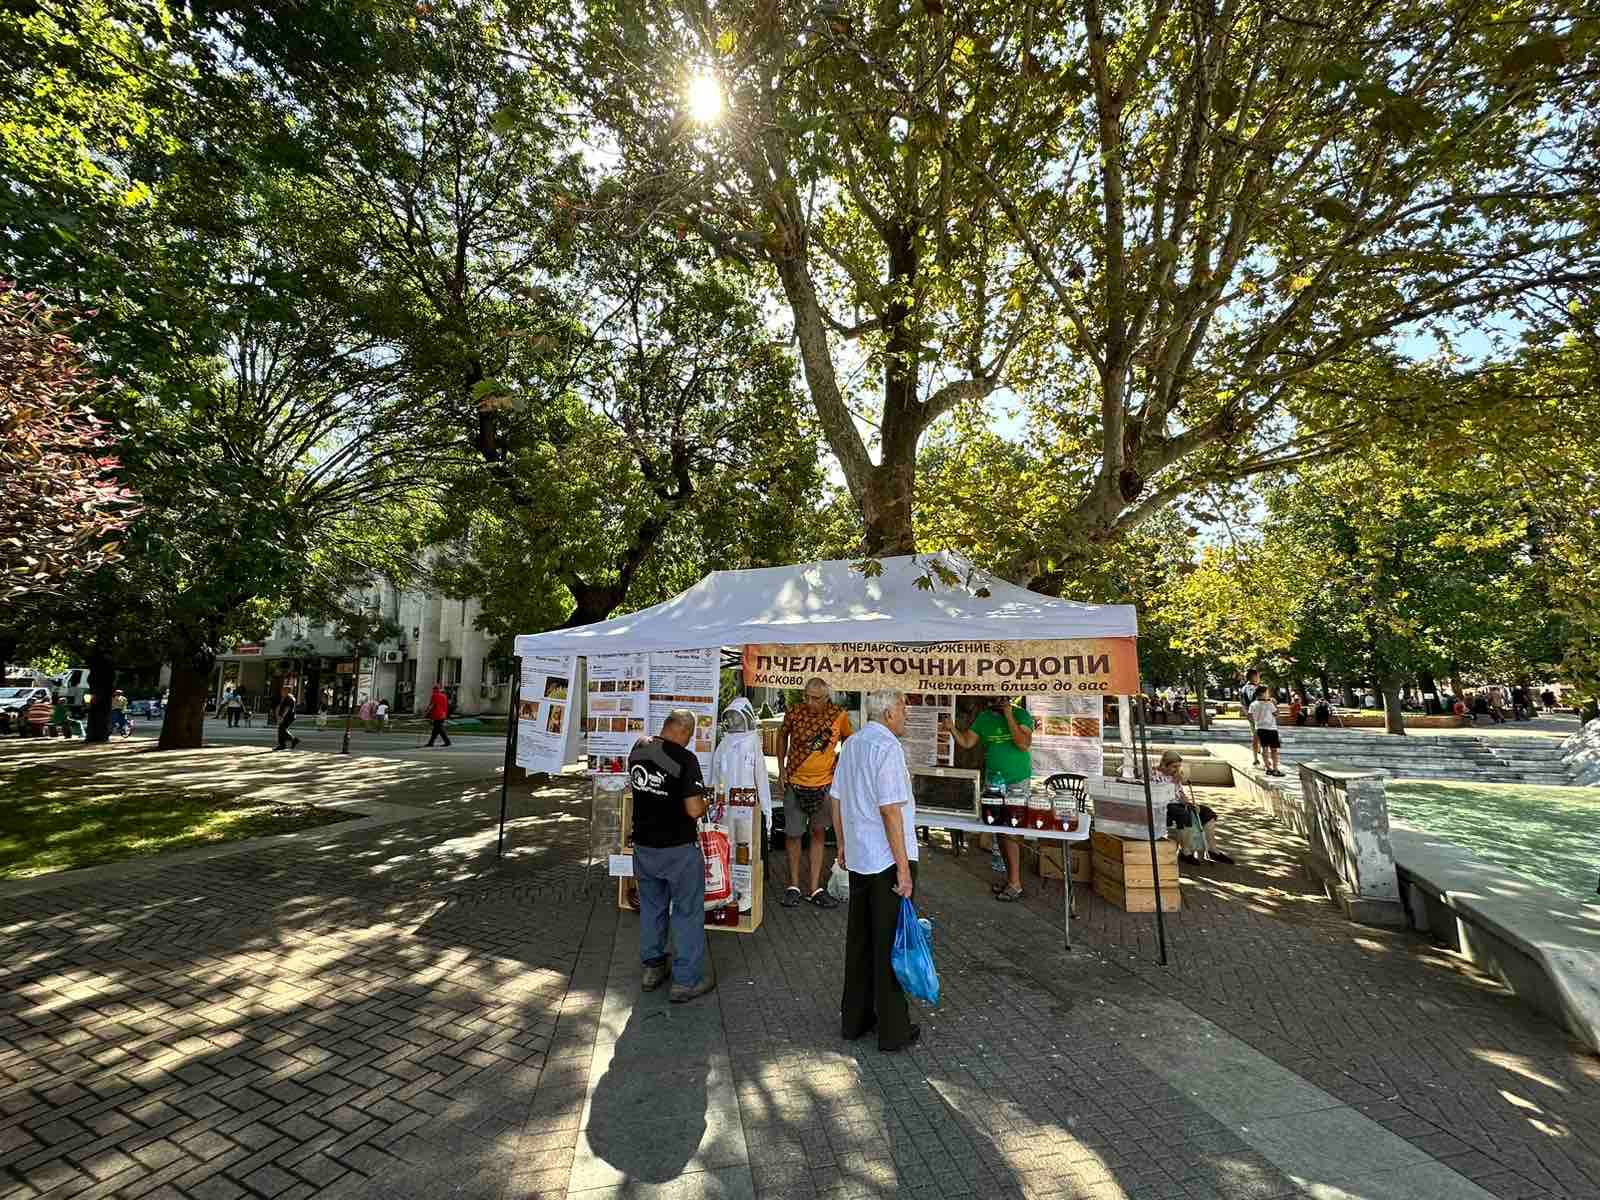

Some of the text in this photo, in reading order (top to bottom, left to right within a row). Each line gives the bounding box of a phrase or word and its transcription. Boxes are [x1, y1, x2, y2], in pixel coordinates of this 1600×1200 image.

[841, 642, 908, 653] ПЧЕЛАРСКО
[757, 654, 1110, 679] ПЧЕЛА-ИЗТОЧНИ РОДОПИ
[755, 675, 803, 685] ХАСКОВО
[918, 678, 1108, 693] Пчеларят близо до вас
